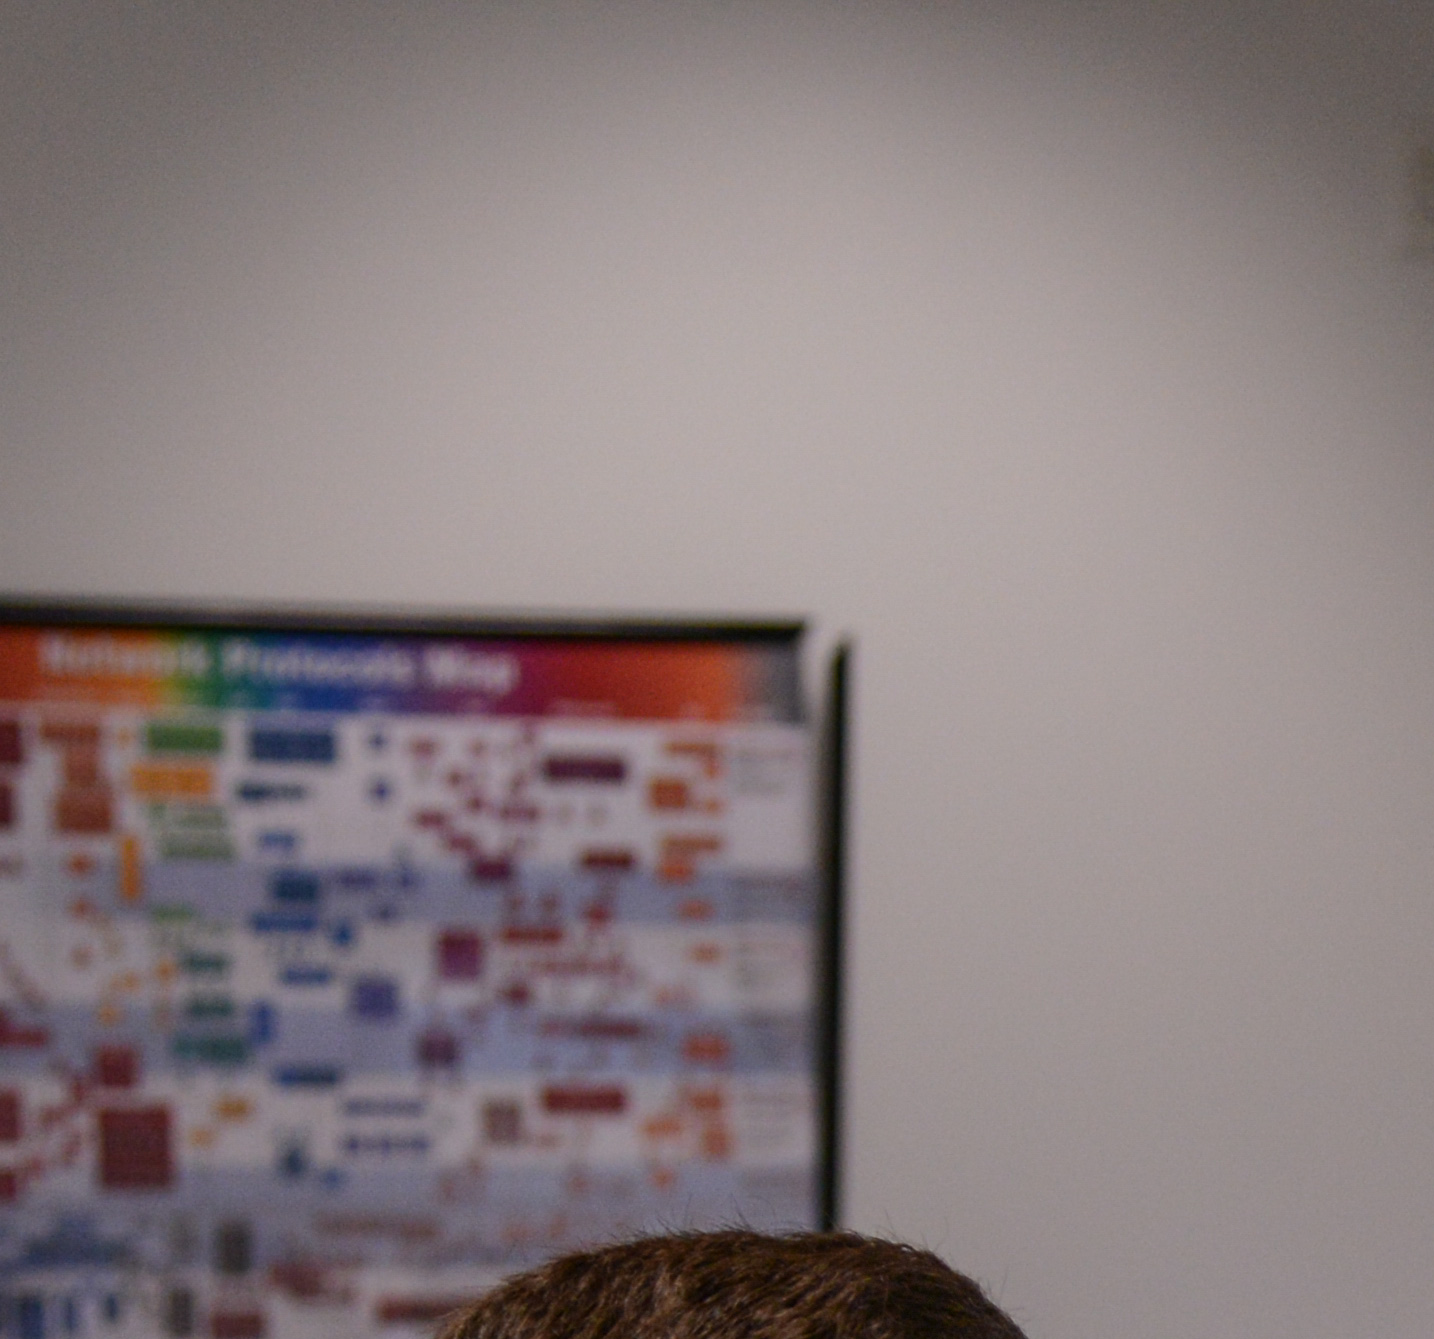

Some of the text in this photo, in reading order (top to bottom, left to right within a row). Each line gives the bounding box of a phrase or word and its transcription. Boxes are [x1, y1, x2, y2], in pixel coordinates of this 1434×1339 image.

[38, 631, 522, 696] Network Protocols Map
